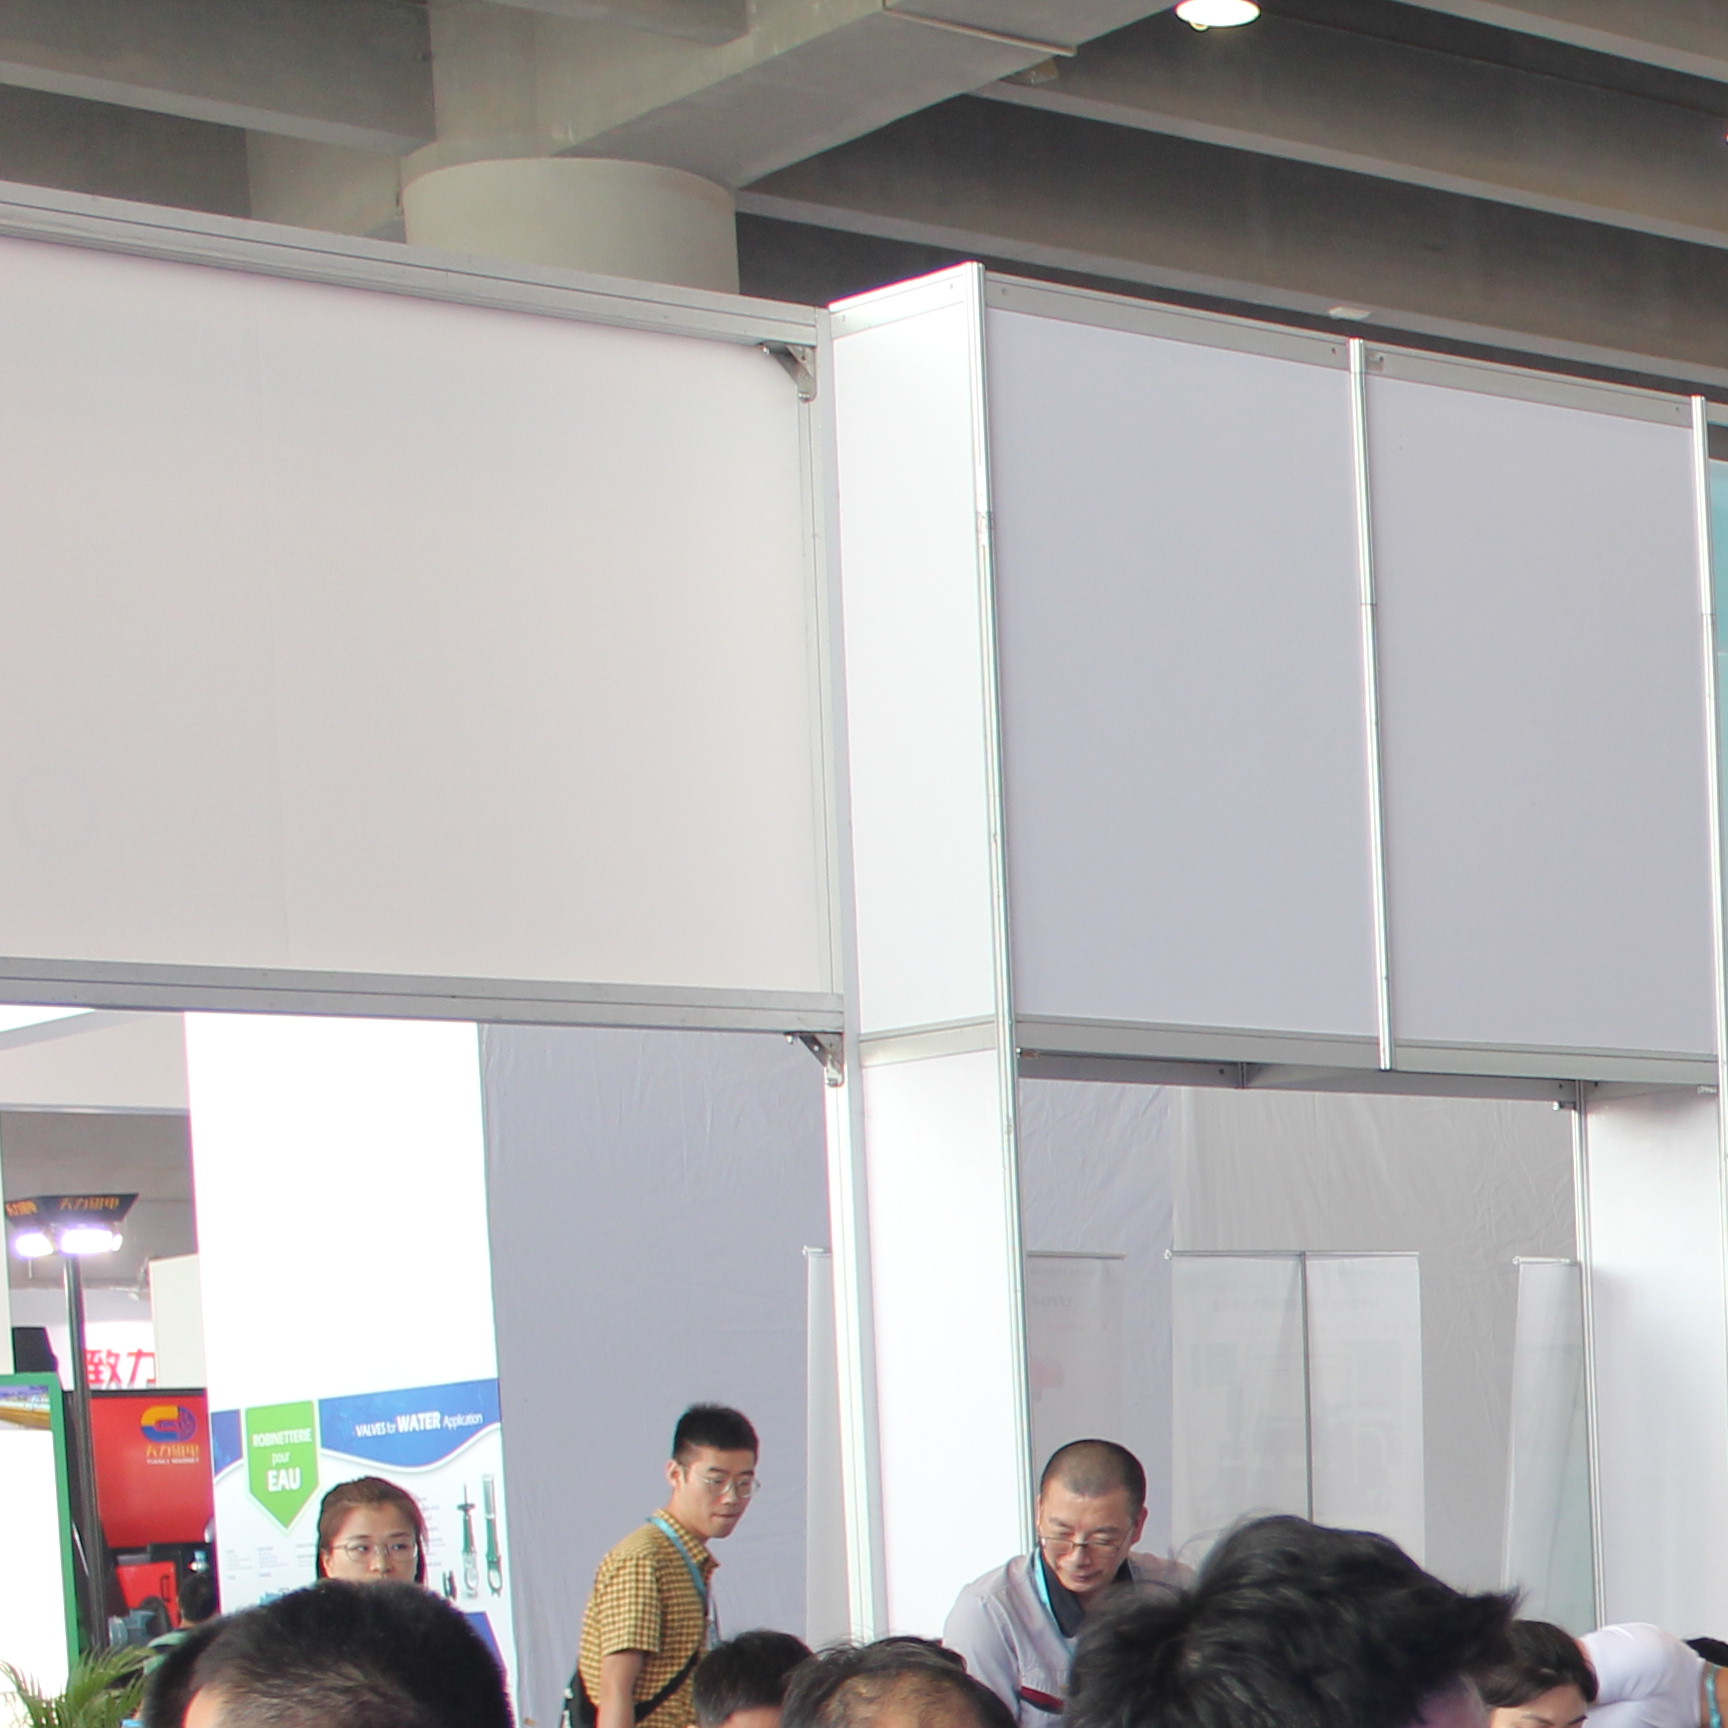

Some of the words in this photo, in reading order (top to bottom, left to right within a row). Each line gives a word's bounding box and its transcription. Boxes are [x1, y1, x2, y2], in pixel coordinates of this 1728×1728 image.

[355, 1421, 386, 1438] VALVES
[387, 1421, 397, 1434] for
[396, 1411, 441, 1433] WATER
[443, 1413, 483, 1431] Application
[252, 1428, 312, 1448] ROBINETTERIE
[272, 1452, 290, 1467] pour
[267, 1467, 301, 1492] EAU
